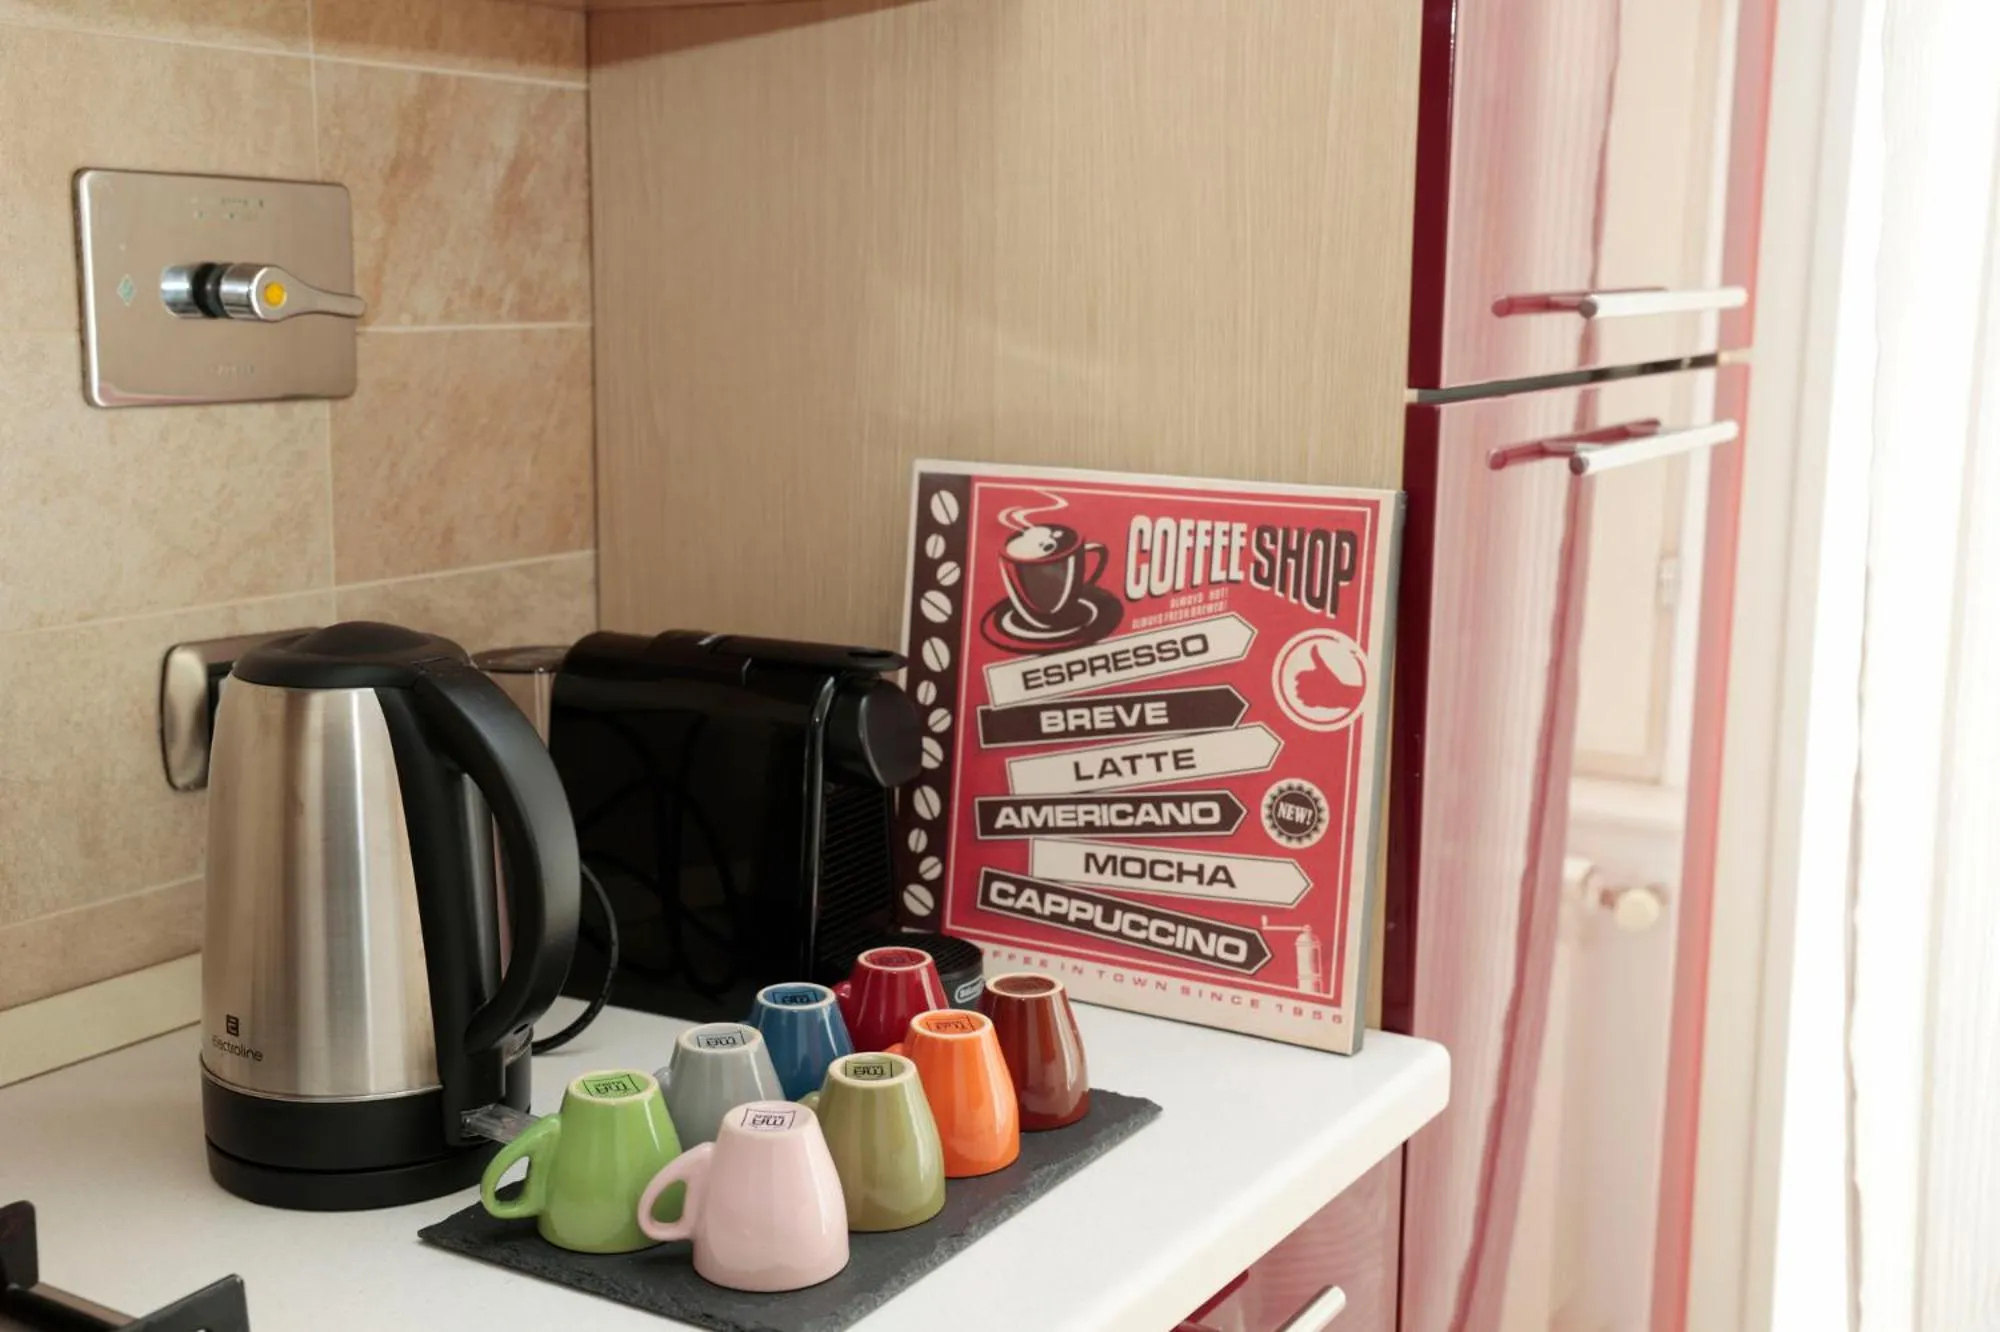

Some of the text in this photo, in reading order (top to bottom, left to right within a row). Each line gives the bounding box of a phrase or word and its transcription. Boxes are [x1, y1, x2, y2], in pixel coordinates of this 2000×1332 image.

[1125, 514, 1358, 619] COFFEE SHOP
[1021, 633, 1210, 691] ESPRESSO
[1040, 701, 1169, 734] BREVE
[1073, 748, 1197, 782] LATTE
[994, 801, 1221, 829] AMERICANO
[1277, 801, 1313, 826] NEW!
[1084, 852, 1237, 889] MOCHA
[988, 880, 1249, 964] CAPPUCCINO
[982, 949, 1049, 968] FFEE
[1060, 962, 1084, 975] IN
[1097, 969, 1168, 991] TOWN
[1180, 985, 1260, 1010] SINCE
